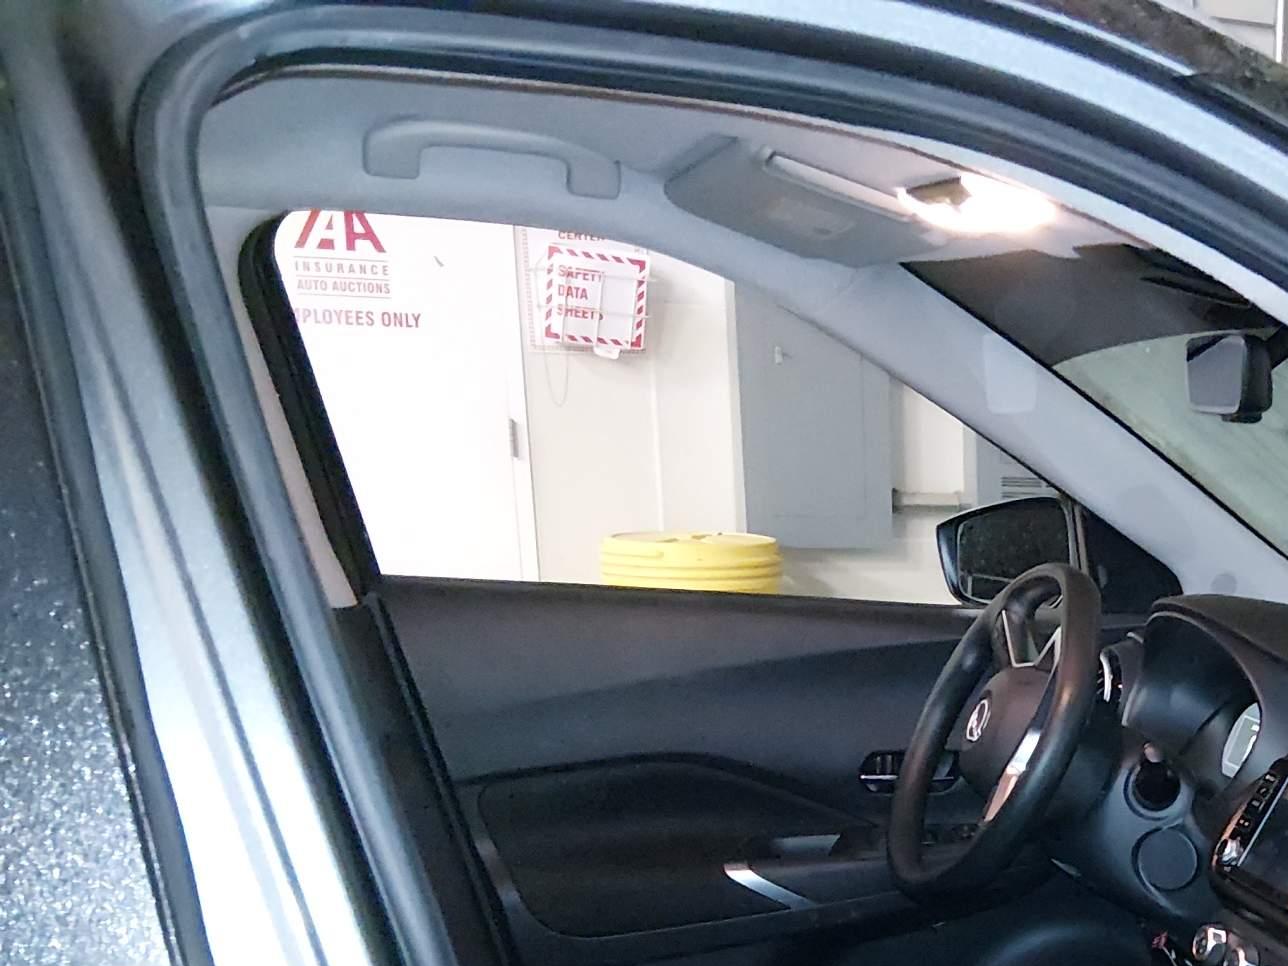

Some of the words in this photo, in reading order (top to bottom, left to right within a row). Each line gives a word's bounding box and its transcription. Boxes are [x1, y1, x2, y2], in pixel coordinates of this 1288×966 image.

[558, 231, 607, 241] CENT
[295, 261, 389, 276] INSURANCE
[297, 279, 328, 291] AUTO
[332, 281, 391, 294] AUCTIONS
[558, 284, 588, 300] DATA
[295, 307, 375, 327] PLOYEES
[381, 311, 421, 328] ONLY
